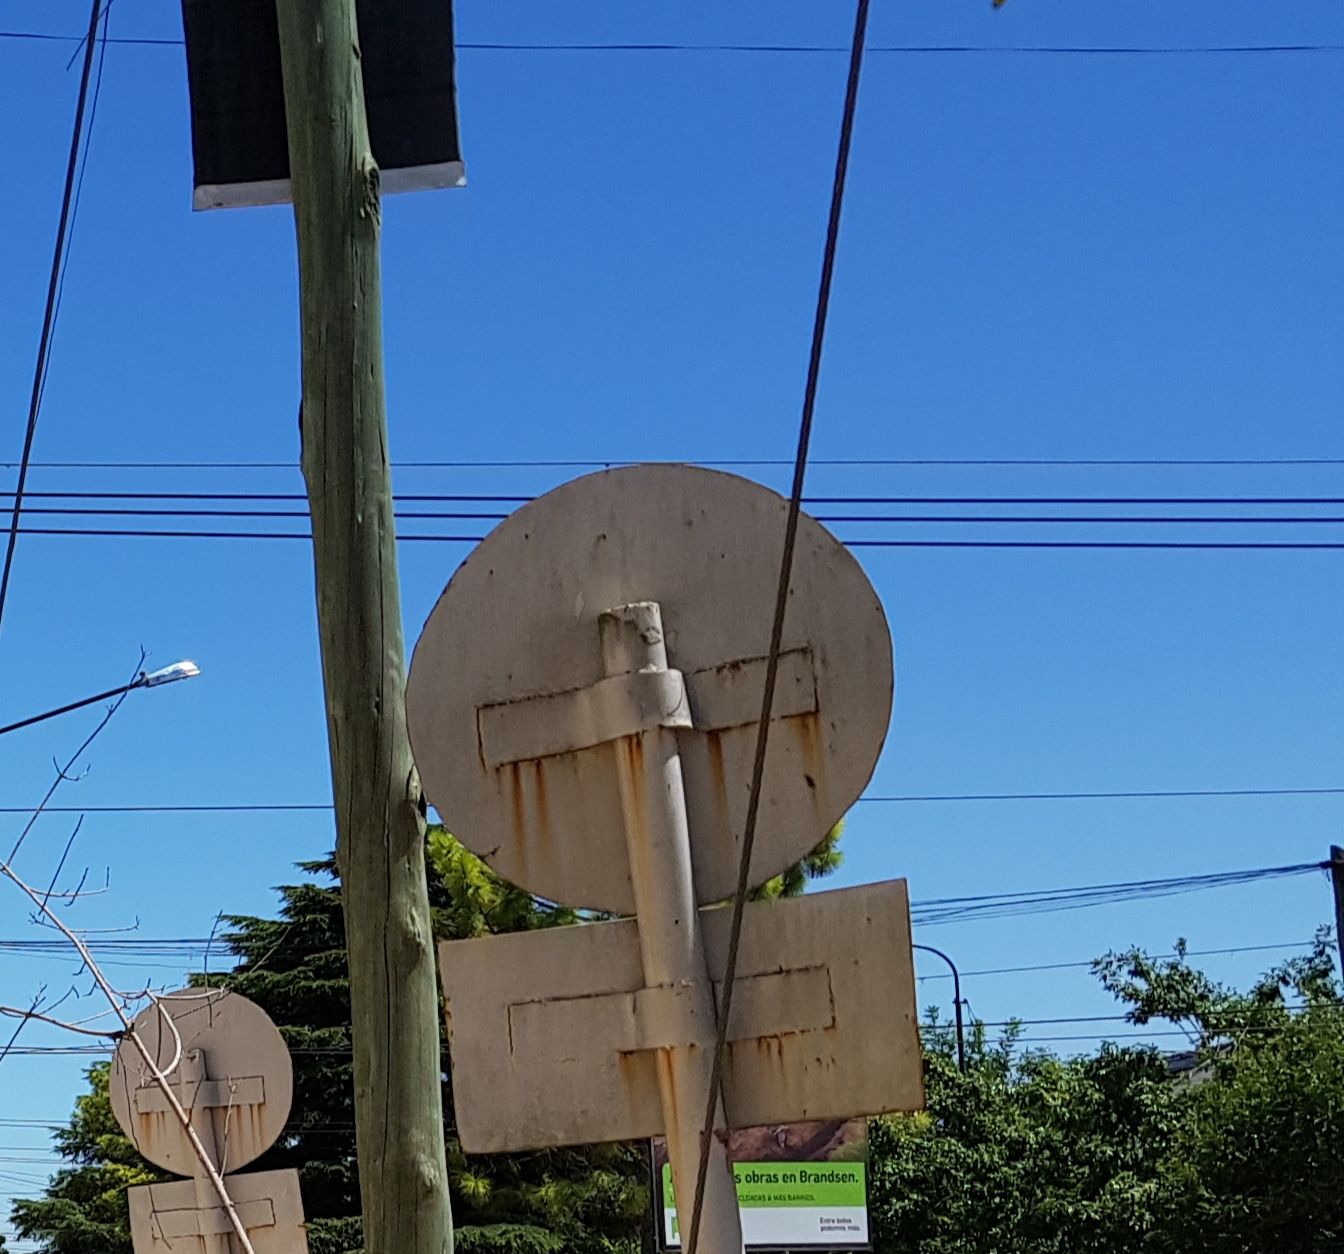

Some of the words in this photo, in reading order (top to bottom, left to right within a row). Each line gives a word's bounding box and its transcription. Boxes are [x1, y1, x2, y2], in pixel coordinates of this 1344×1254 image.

[744, 1170, 780, 1184] obras
[782, 1173, 797, 1184] en
[799, 1170, 859, 1184] Brandsen.
